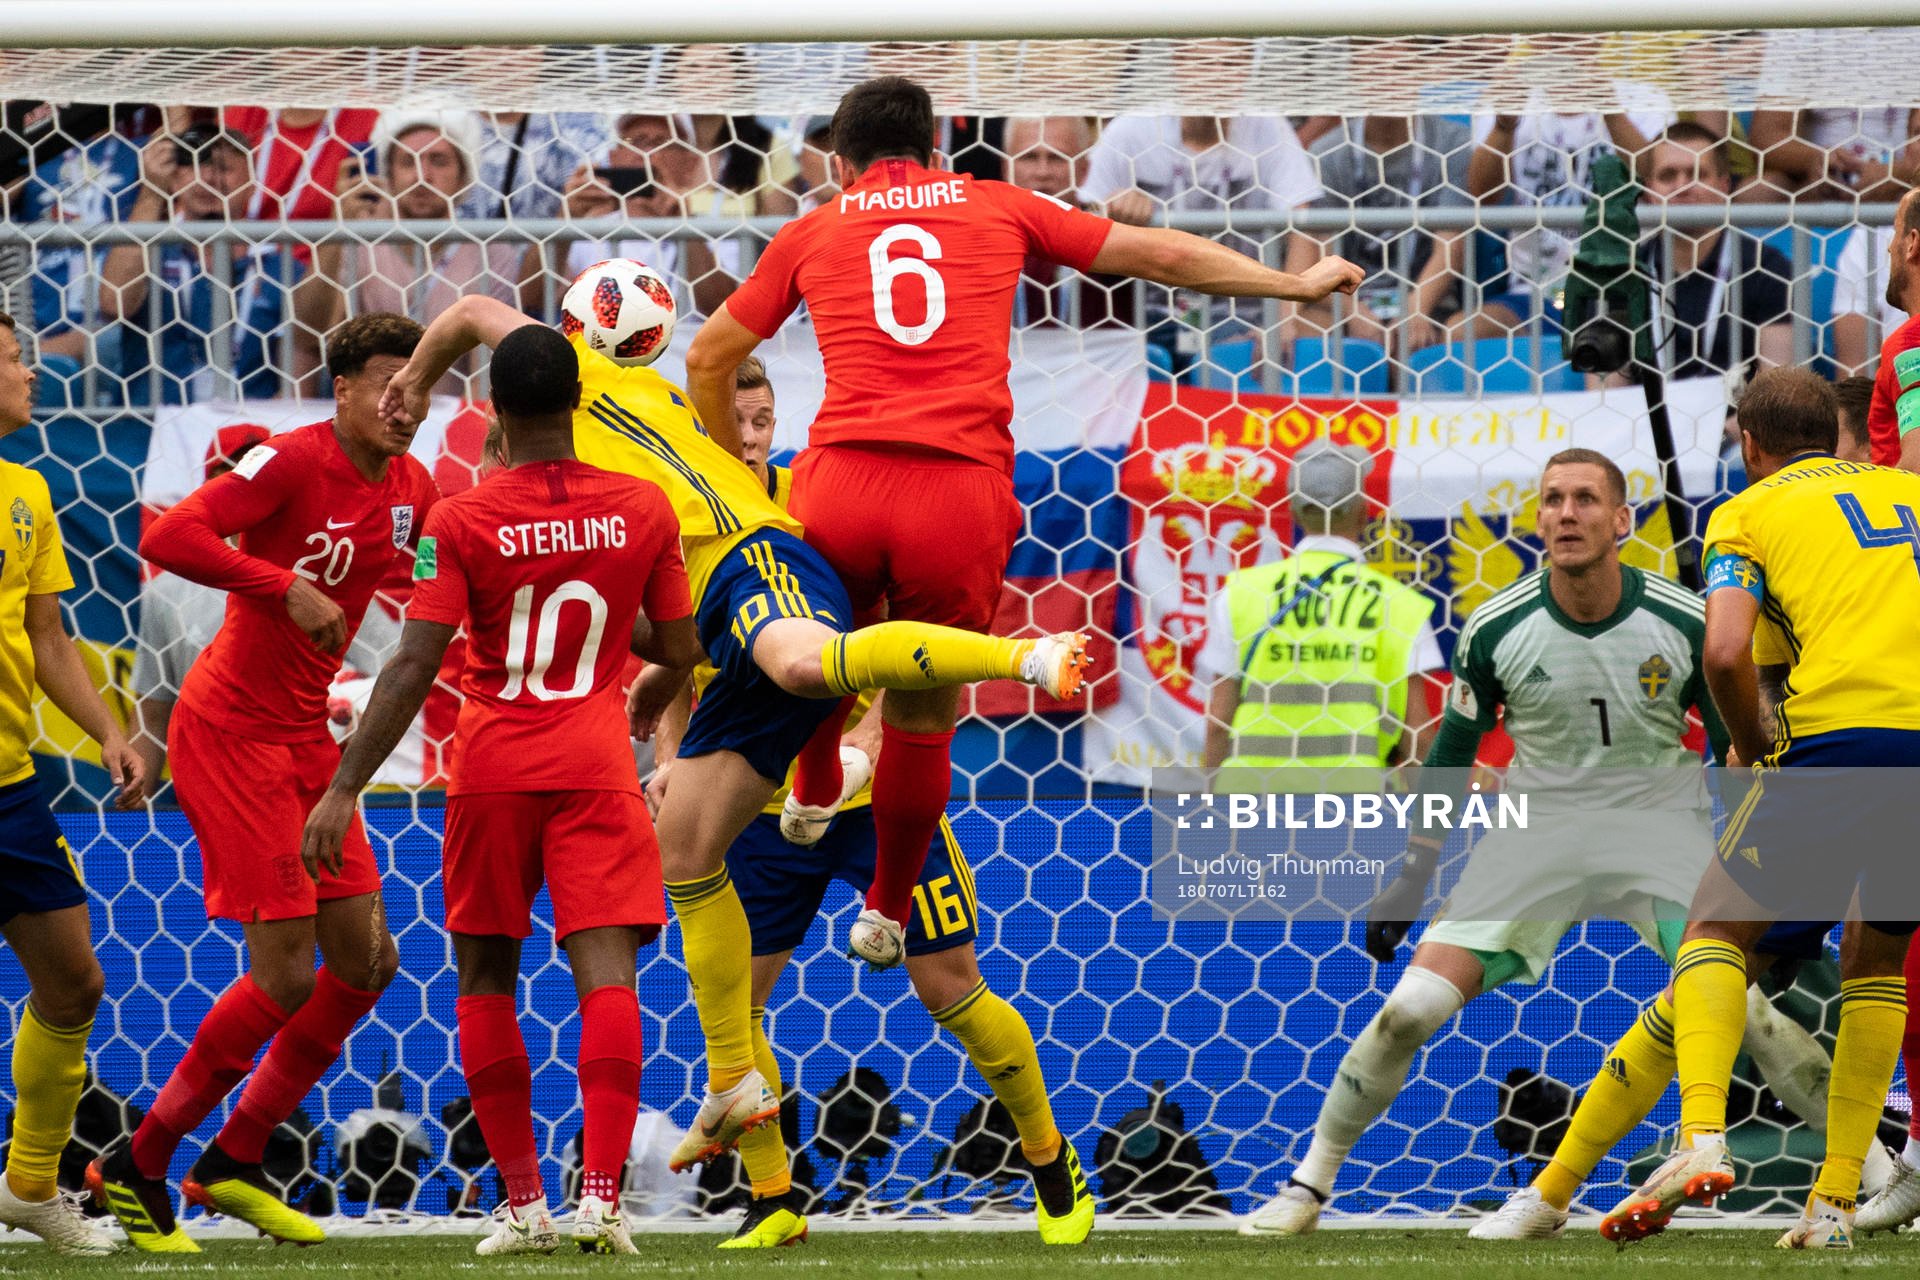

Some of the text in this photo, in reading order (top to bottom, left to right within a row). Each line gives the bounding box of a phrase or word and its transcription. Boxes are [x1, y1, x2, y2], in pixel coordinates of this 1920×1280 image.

[840, 180, 967, 214] MAGUIRE
[868, 223, 947, 346] 6
[292, 531, 354, 586] 20
[497, 515, 626, 557] STERLING
[1833, 492, 1920, 580] 4
[497, 579, 609, 701] 10
[731, 592, 770, 648] 10
[1270, 644, 1376, 662] STEWARD
[1590, 698, 1611, 746] 1
[912, 874, 969, 940] 16
